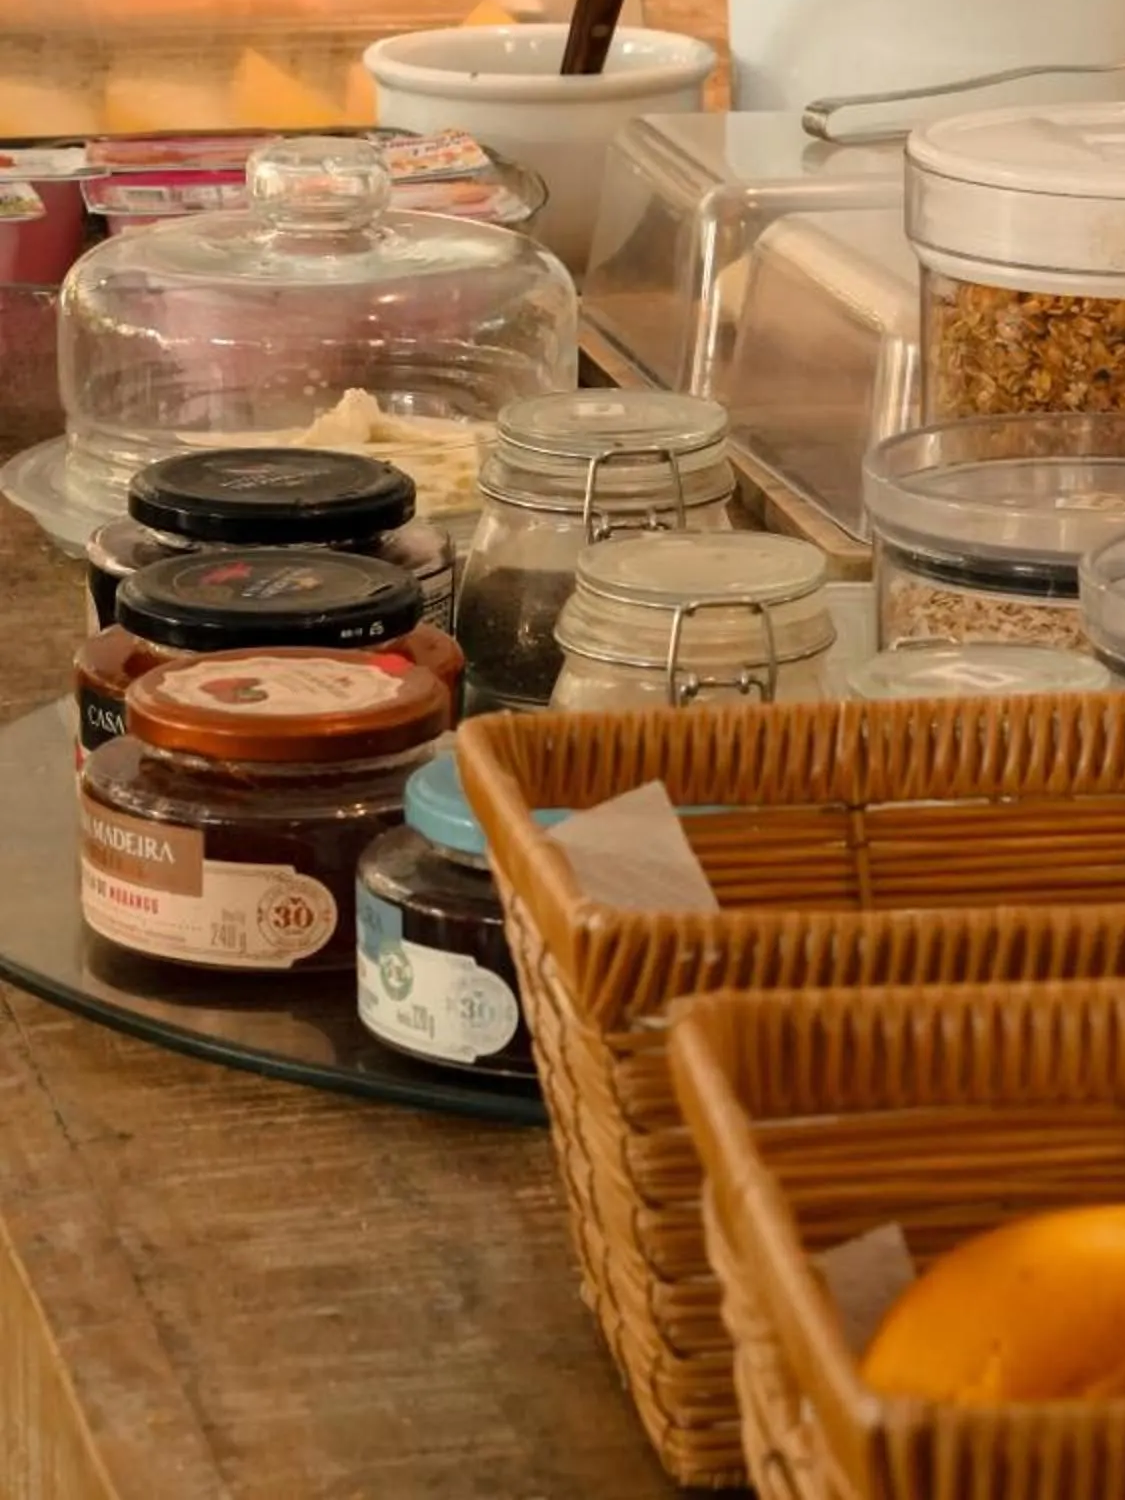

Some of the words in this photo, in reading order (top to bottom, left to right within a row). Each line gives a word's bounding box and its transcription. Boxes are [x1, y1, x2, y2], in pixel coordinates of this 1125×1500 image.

[87, 704, 126, 736] CASA
[92, 818, 176, 864] MADEIRA
[273, 905, 314, 929] 30
